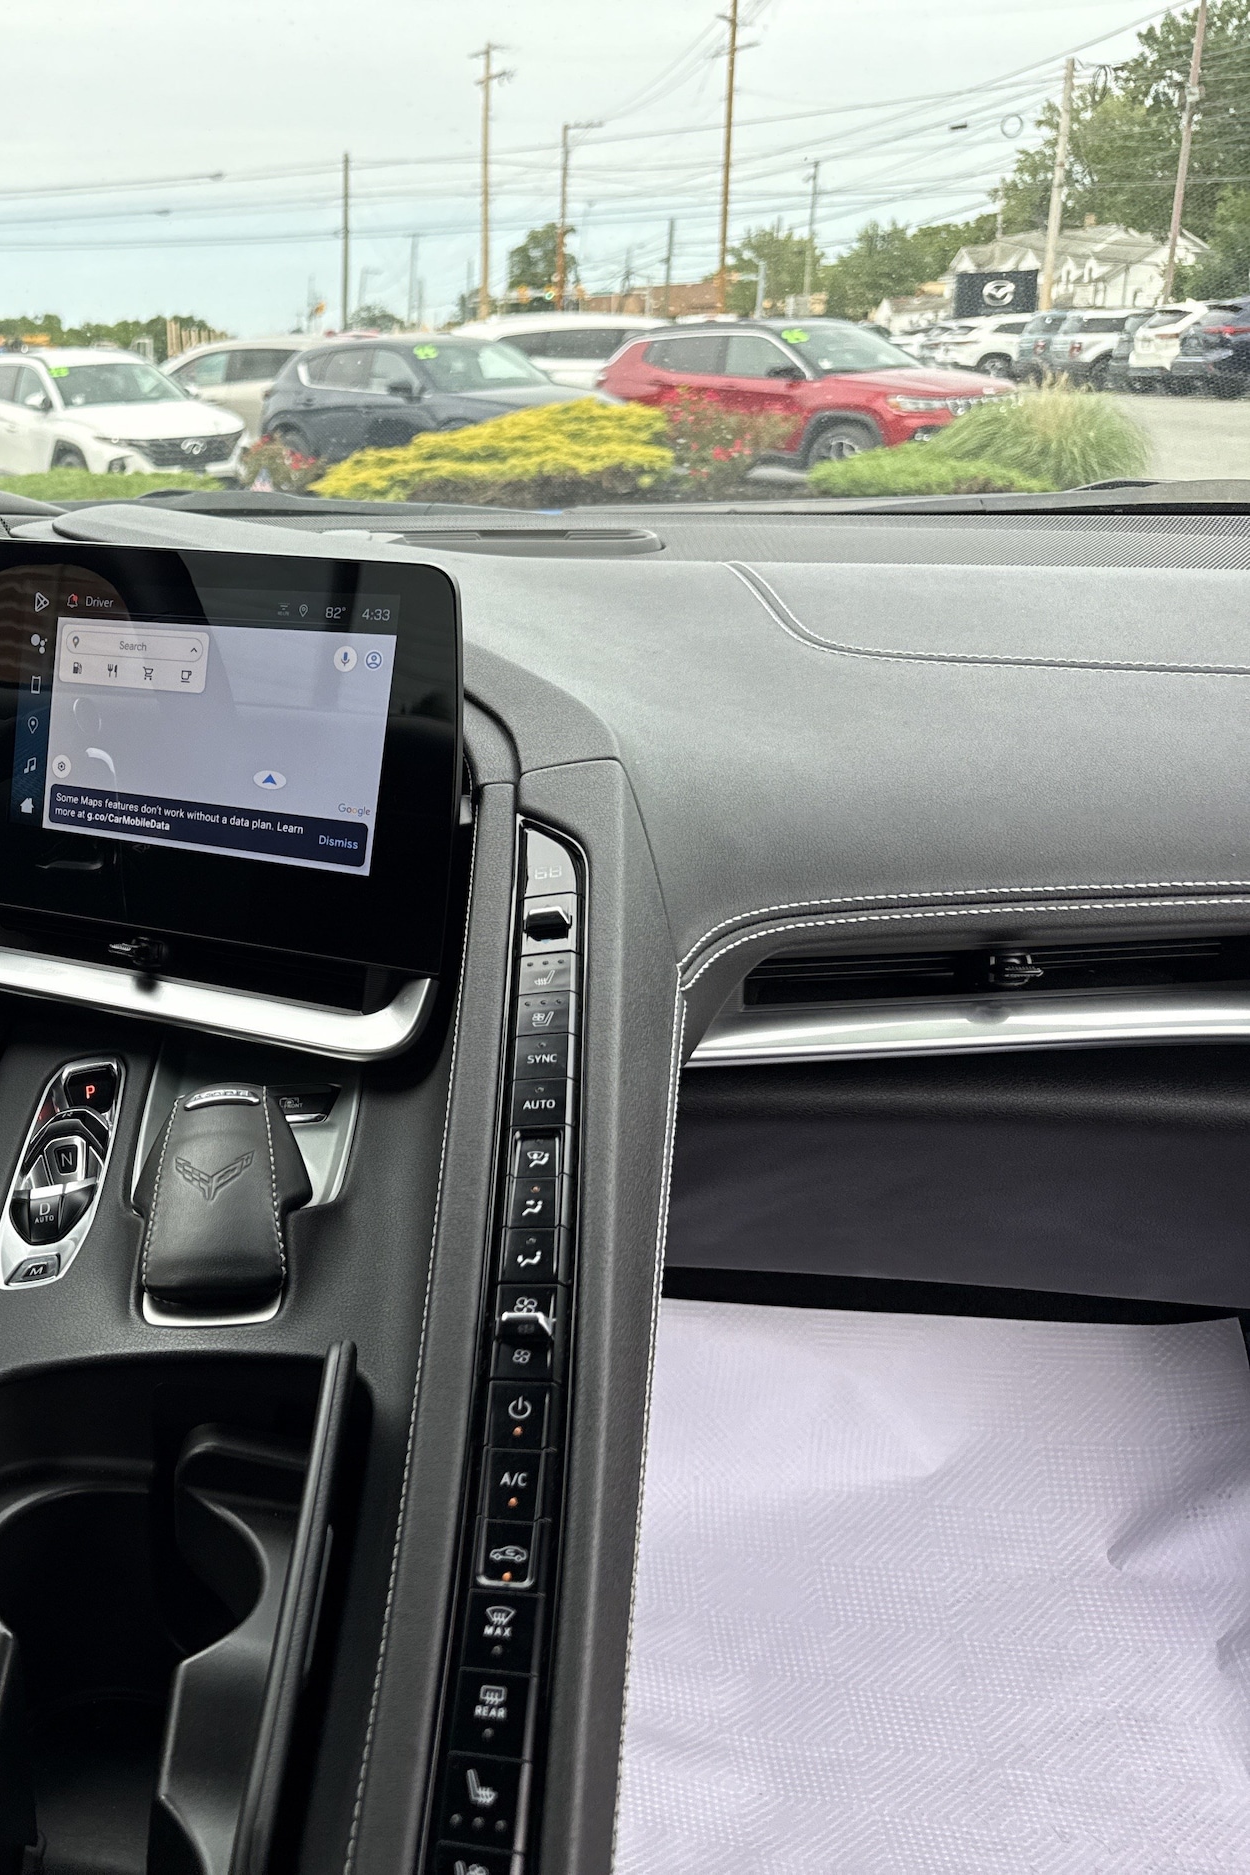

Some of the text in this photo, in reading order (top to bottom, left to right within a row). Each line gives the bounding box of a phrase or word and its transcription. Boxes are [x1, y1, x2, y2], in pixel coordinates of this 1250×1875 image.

[86, 596, 114, 608] Driver
[326, 606, 346, 618] 82°
[362, 608, 390, 621] 4:33
[120, 641, 147, 652] Search
[56, 792, 304, 834] Some Maps features don't work without a data plan. Learn
[338, 803, 370, 817] Google
[55, 808, 76, 818] more
[86, 812, 170, 831] g.co/CarMobileData
[318, 834, 358, 850] Dismiss
[527, 1054, 557, 1064] SYNC
[86, 1085, 96, 1099] P
[523, 1100, 556, 1110] AUTO
[61, 1153, 73, 1167] N
[39, 1203, 51, 1216] D
[34, 1215, 54, 1224] AUTO
[30, 1267, 44, 1275] M
[500, 1472, 528, 1487] A/C
[484, 1625, 512, 1638] MAX
[474, 1705, 506, 1718] REAR
